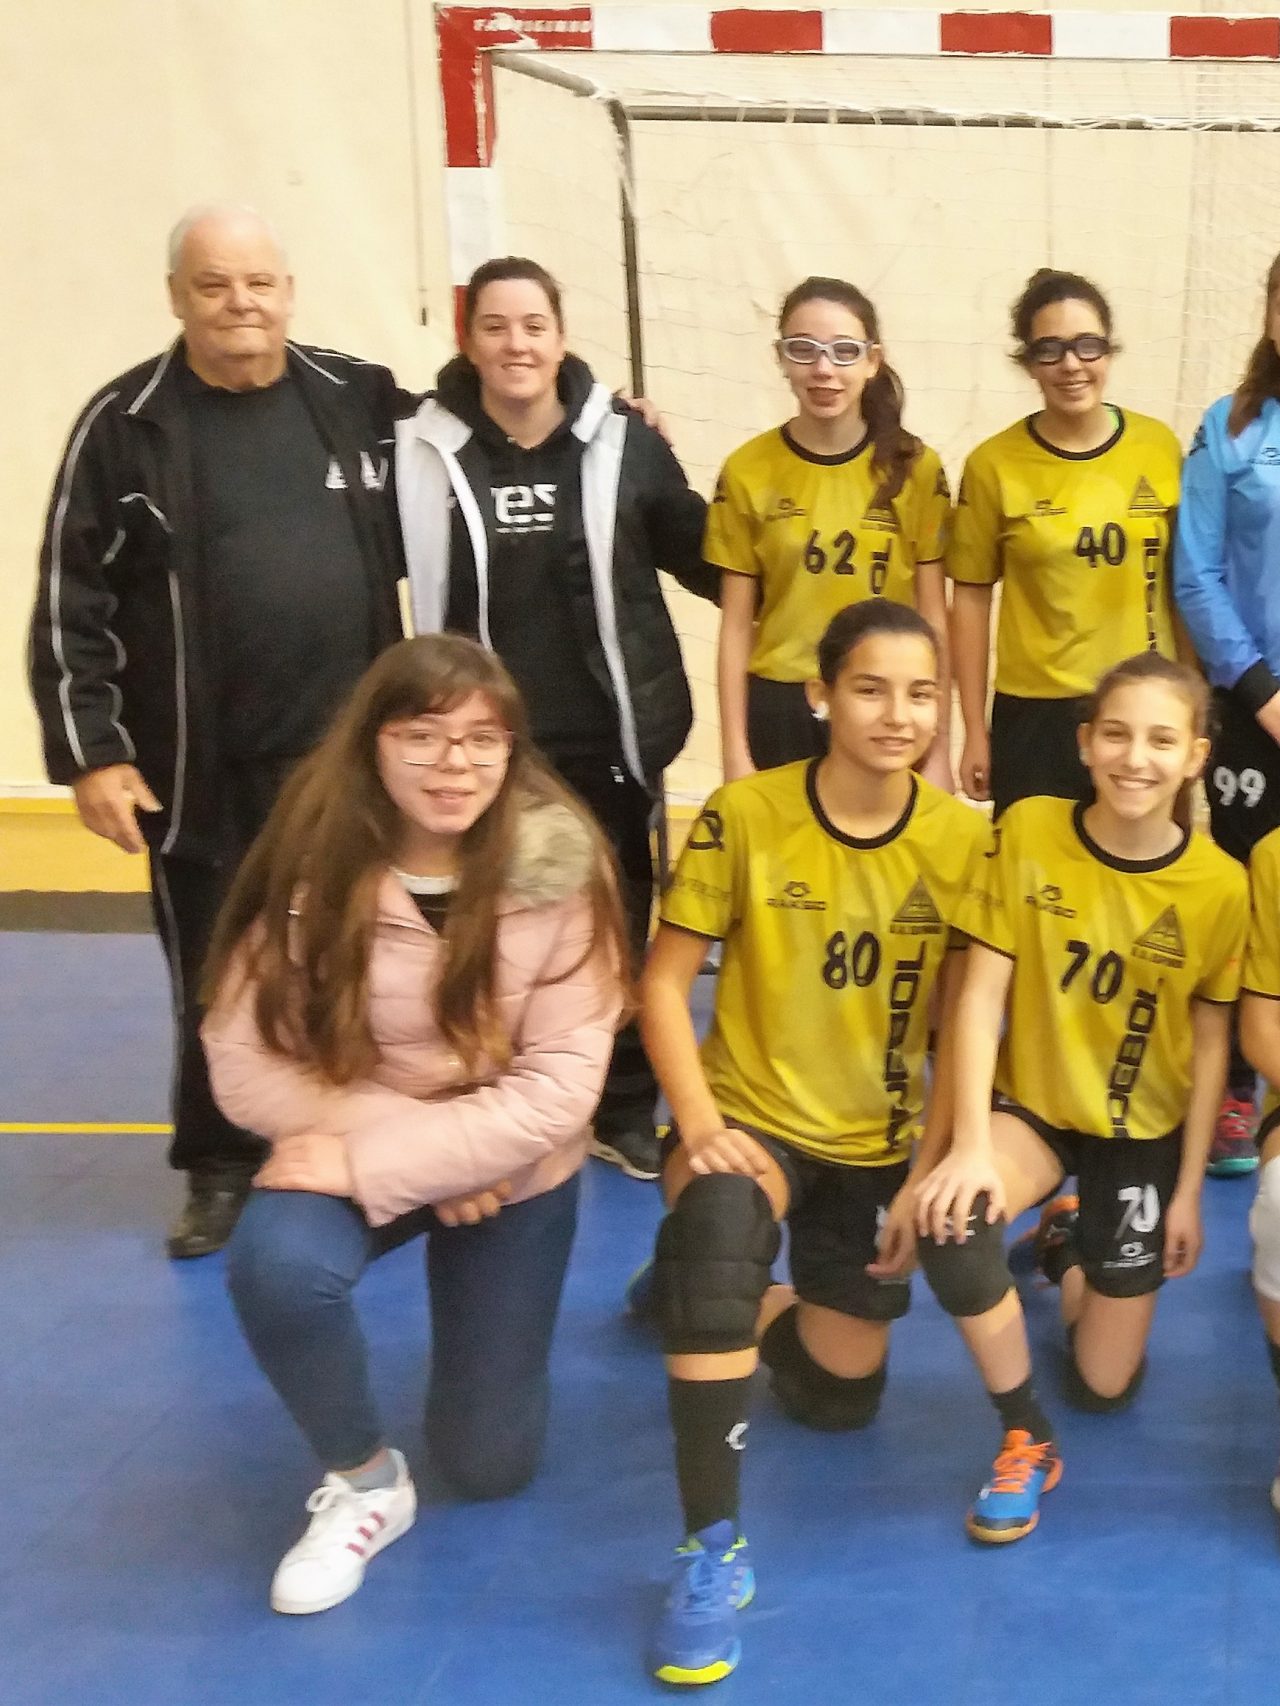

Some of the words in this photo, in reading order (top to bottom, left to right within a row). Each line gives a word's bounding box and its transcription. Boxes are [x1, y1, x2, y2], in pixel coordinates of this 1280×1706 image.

[804, 529, 857, 575] 62
[1076, 522, 1126, 568] 40
[1213, 766, 1266, 808] 99
[822, 931, 880, 989] 80
[1060, 939, 1123, 1004] 70
[1114, 1184, 1160, 1239] 70
